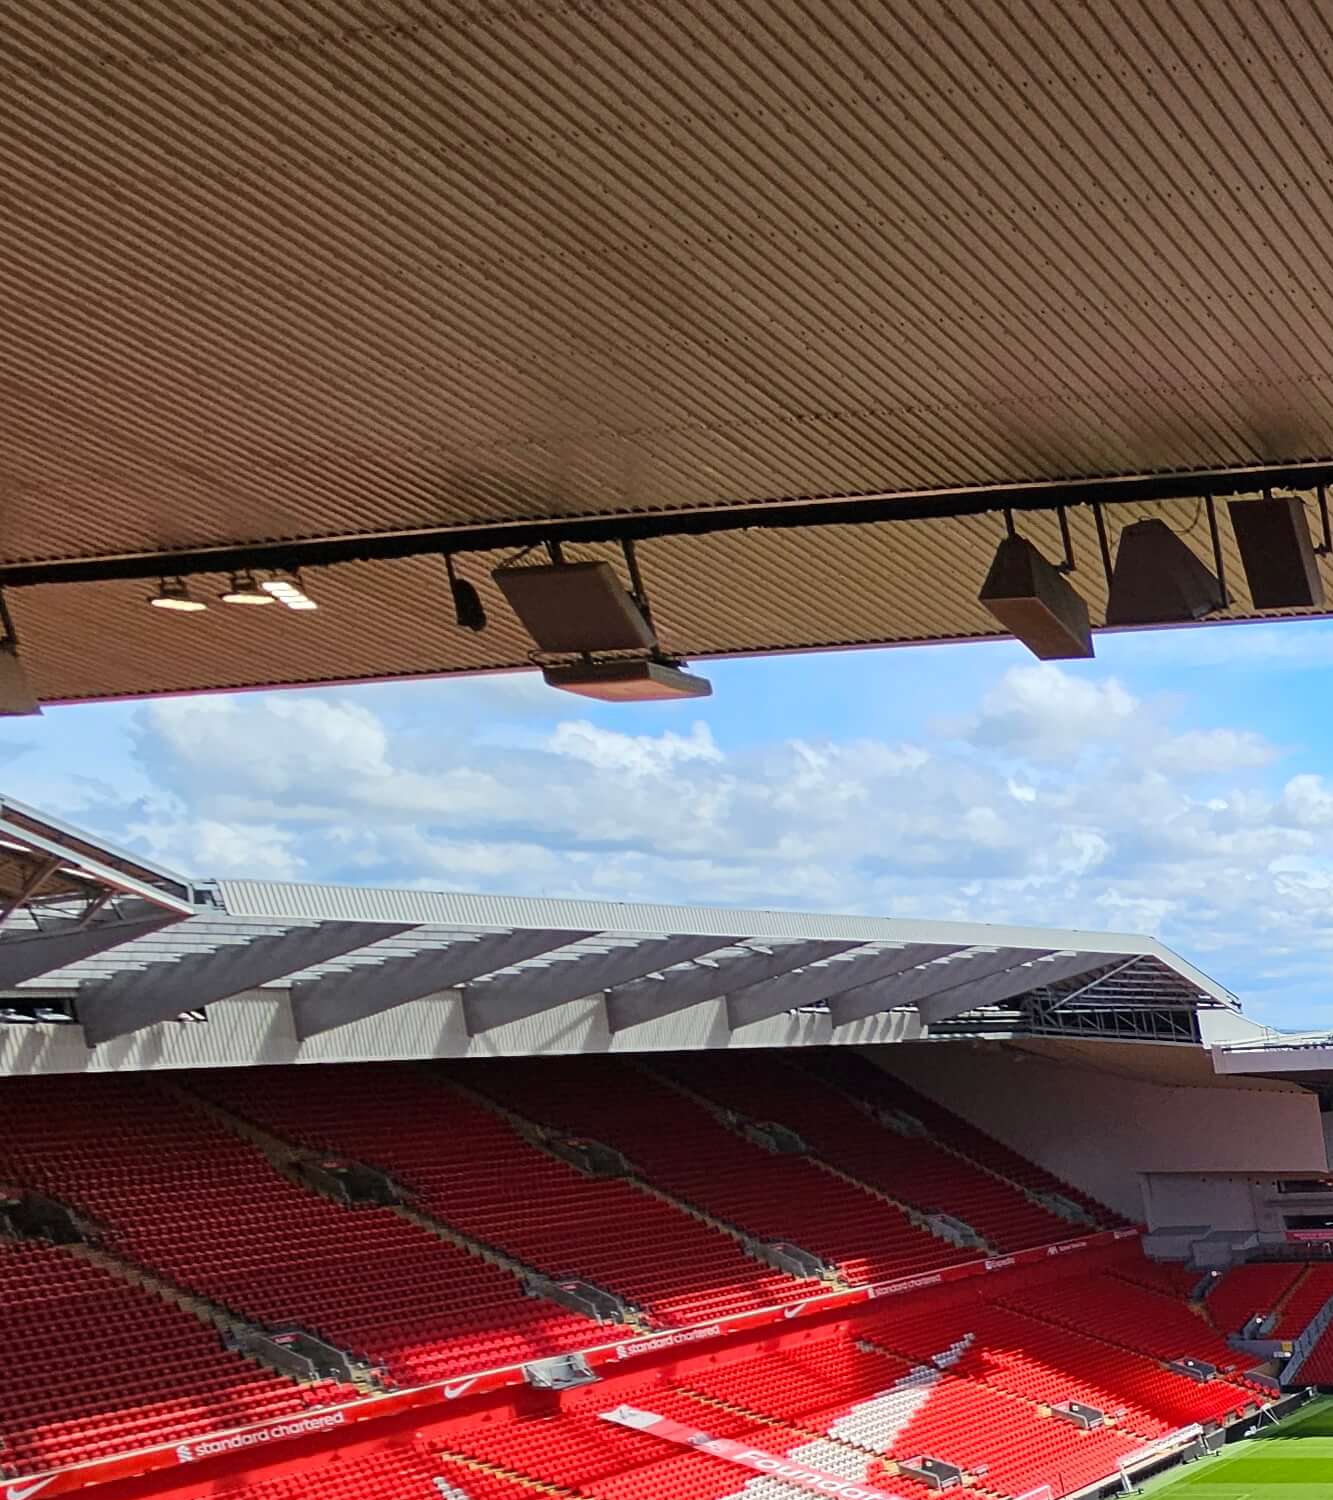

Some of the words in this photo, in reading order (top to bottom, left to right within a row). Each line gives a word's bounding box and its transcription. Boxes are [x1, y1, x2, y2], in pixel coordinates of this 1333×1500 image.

[627, 1334, 673, 1356] standard
[674, 1324, 720, 1344] chartered
[195, 1429, 270, 1457] standard
[271, 1411, 344, 1437] chartered
